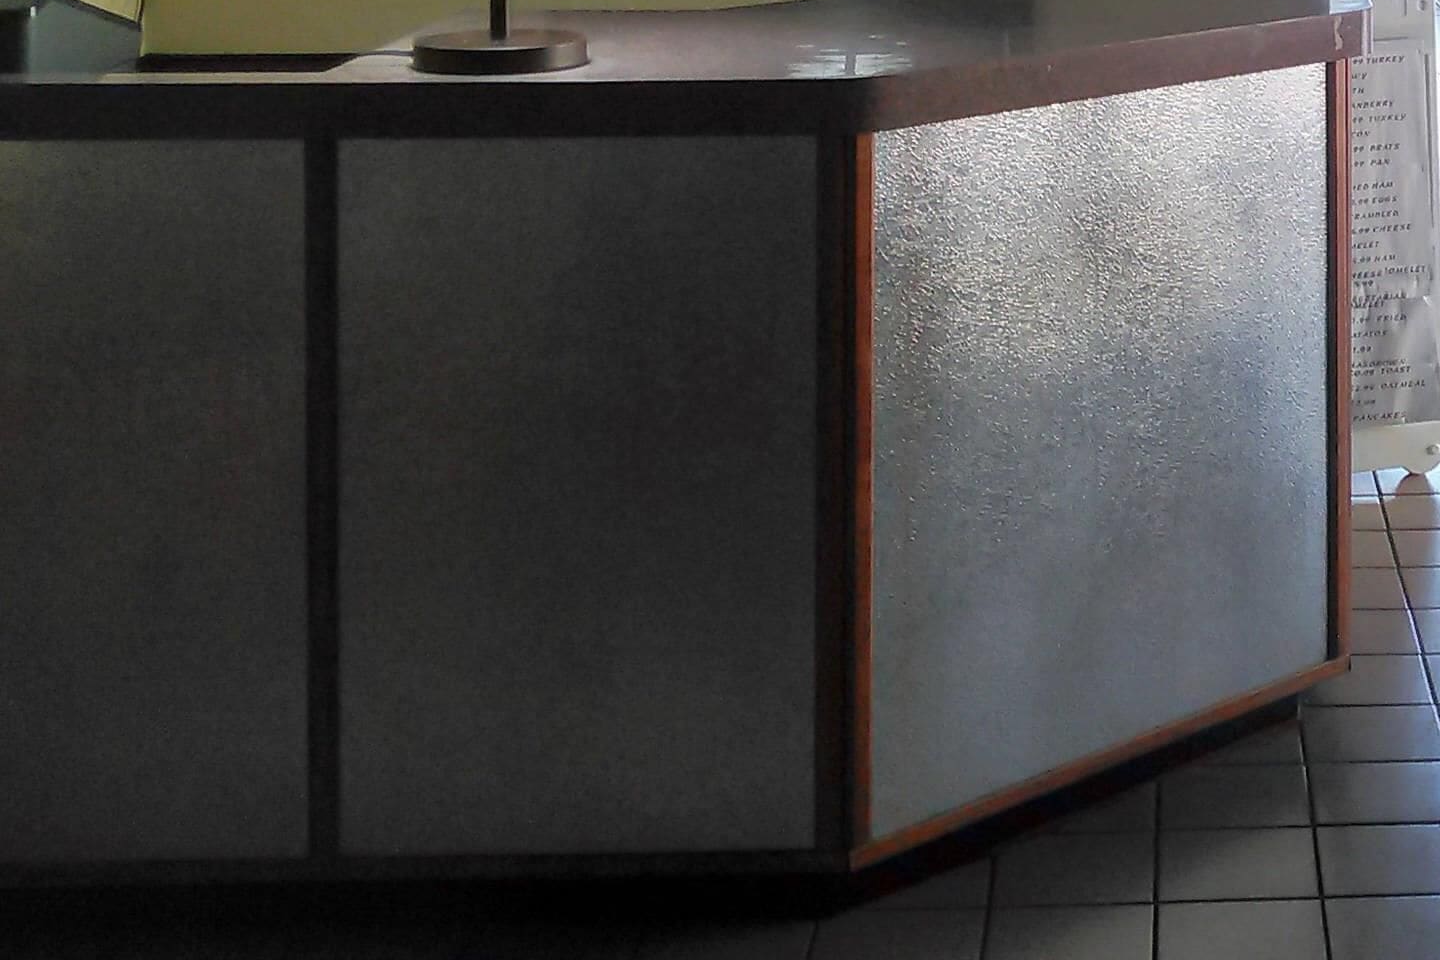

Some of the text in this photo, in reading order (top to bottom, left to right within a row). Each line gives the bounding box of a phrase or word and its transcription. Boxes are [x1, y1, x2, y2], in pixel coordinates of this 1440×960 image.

[1366, 55, 1405, 65] TURKEY
[1351, 209, 1399, 220] RAMBLED
[1372, 223, 1412, 233] CHEESE
[1380, 365, 1411, 375] TOAST
